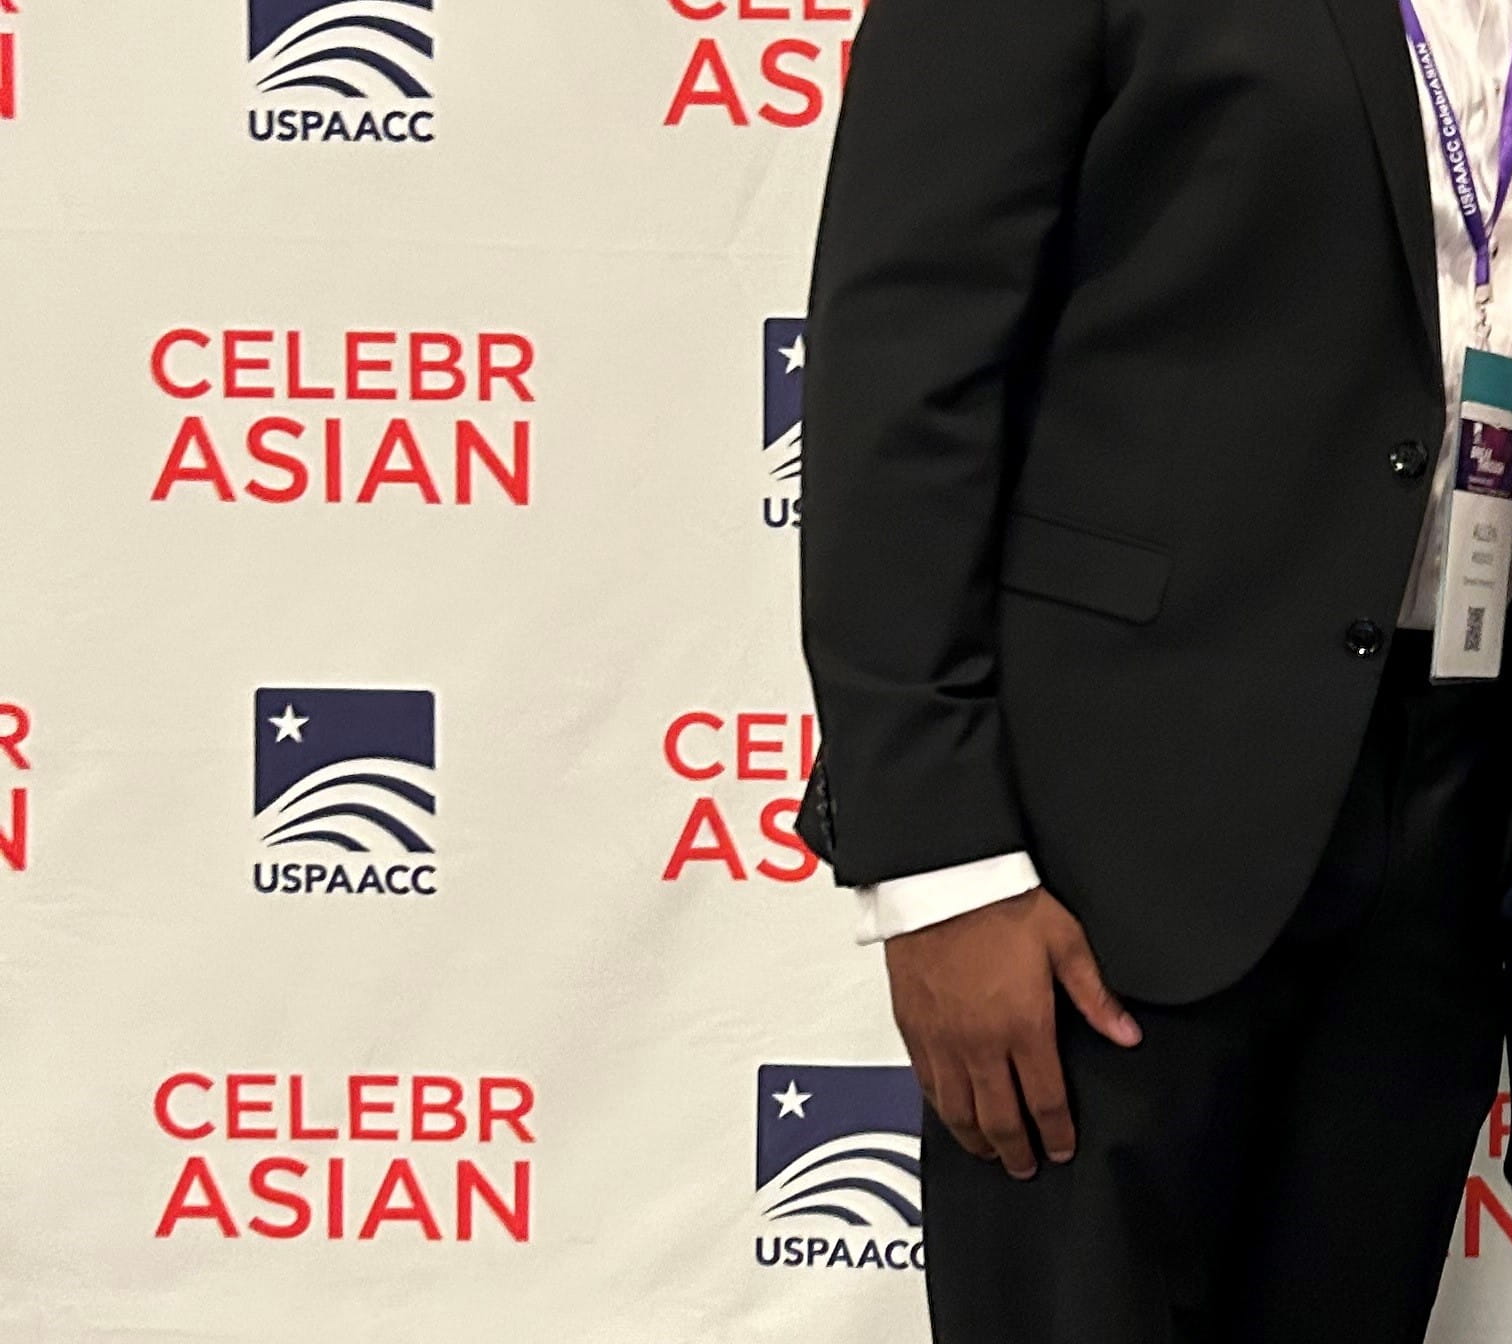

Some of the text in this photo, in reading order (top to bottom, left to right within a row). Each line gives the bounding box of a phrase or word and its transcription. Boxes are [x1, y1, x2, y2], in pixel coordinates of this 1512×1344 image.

[248, 110, 435, 144] USPAACC
[1446, 140, 1477, 216] USPAACC
[149, 328, 535, 403] CELEBR
[150, 415, 531, 507] ASIAN
[253, 862, 437, 896] USPAACC
[153, 1071, 536, 1144] CELEBR
[154, 1155, 532, 1243] ASIAN
